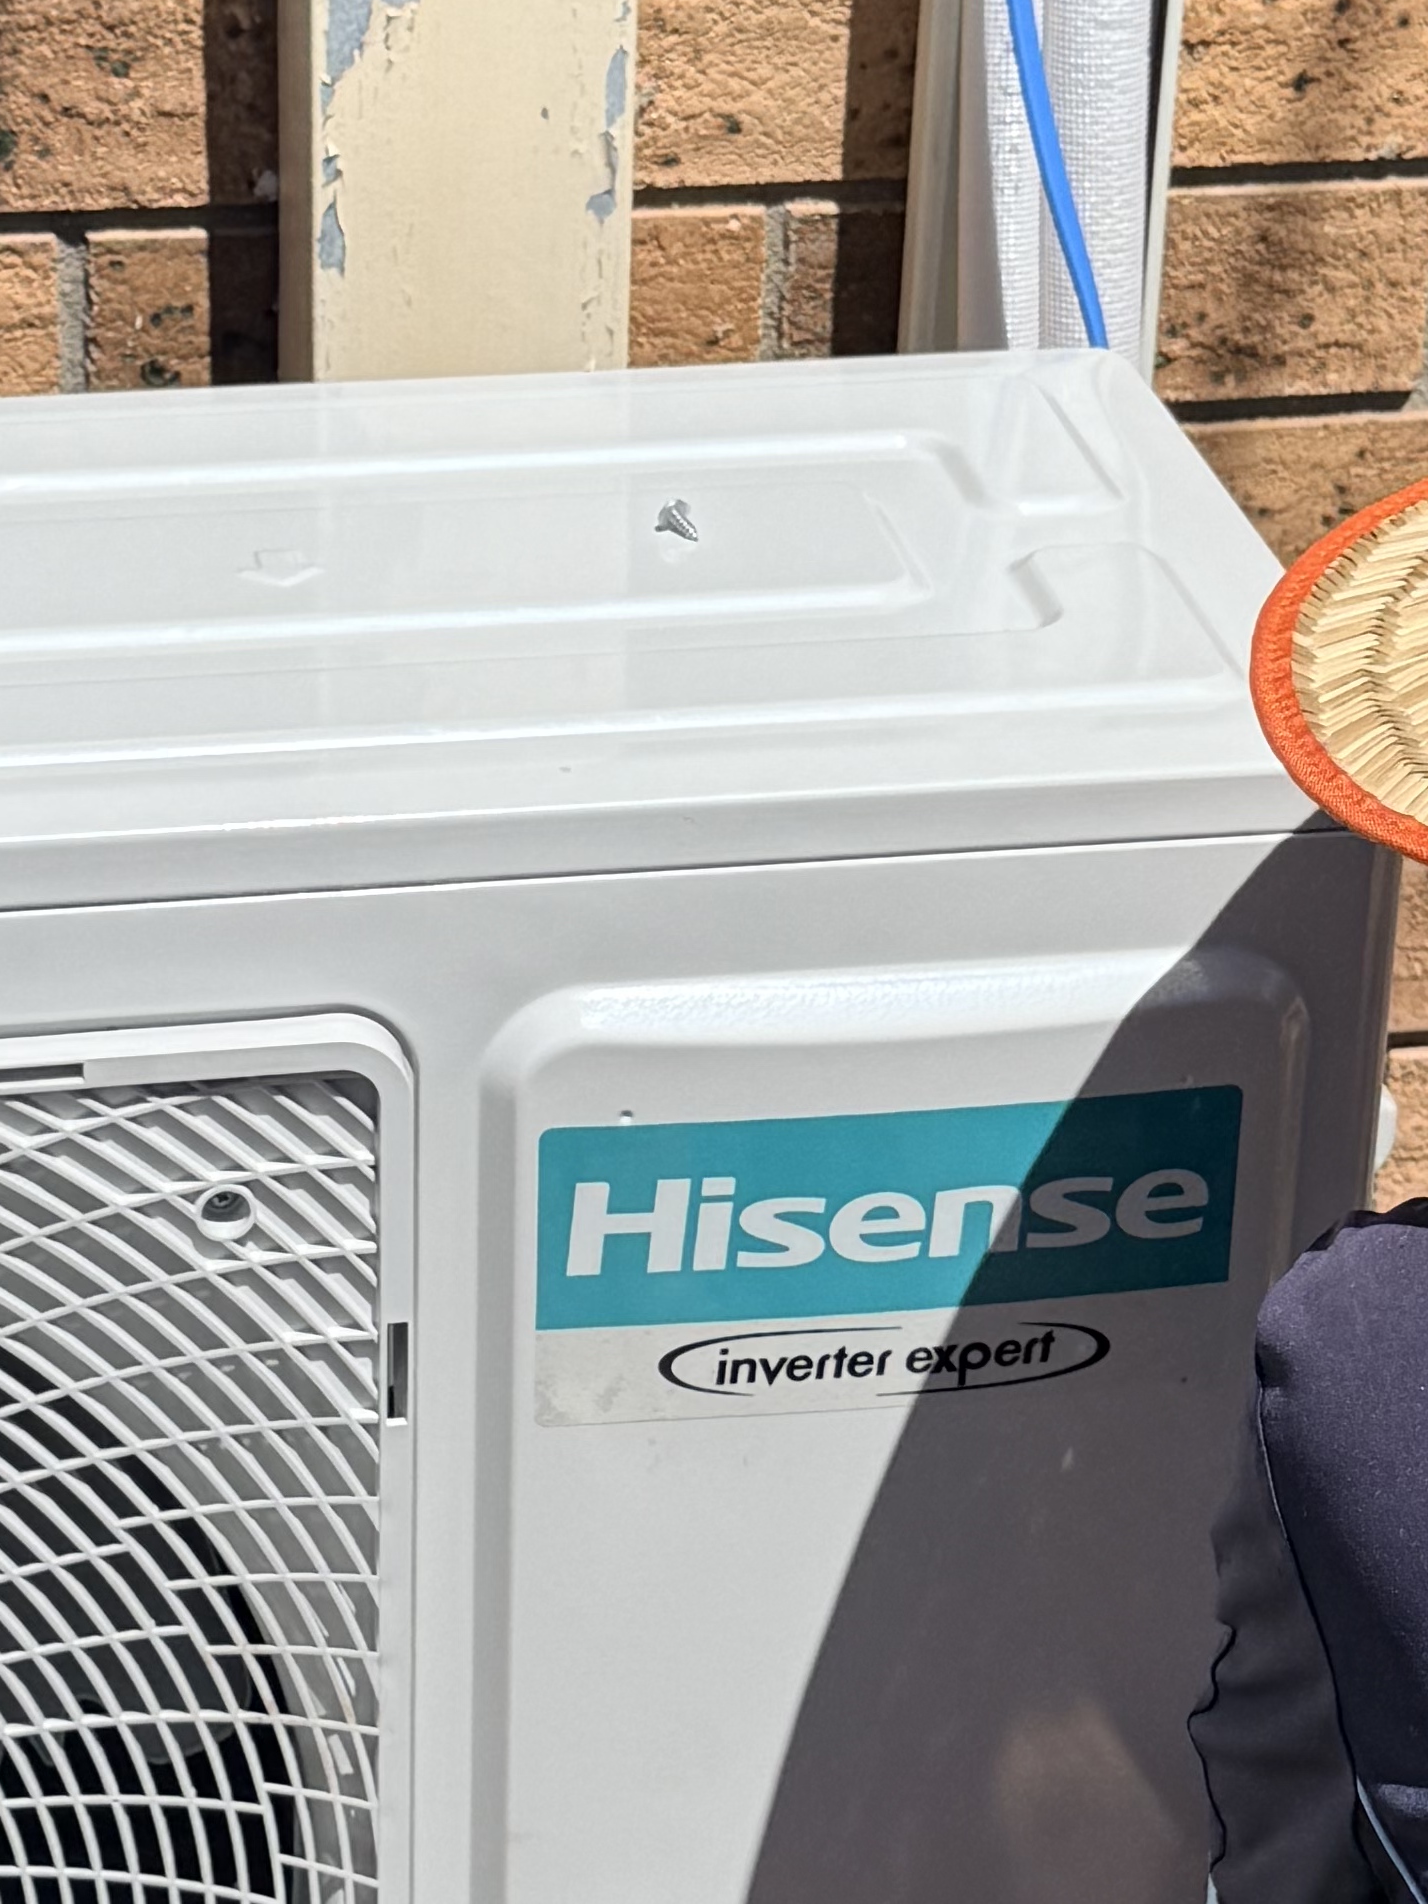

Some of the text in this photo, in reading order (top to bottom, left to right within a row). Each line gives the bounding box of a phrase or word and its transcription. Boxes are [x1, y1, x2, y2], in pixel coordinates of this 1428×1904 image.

[566, 1168, 1209, 1277] Hisense
[715, 1330, 1055, 1387] inverter expert
